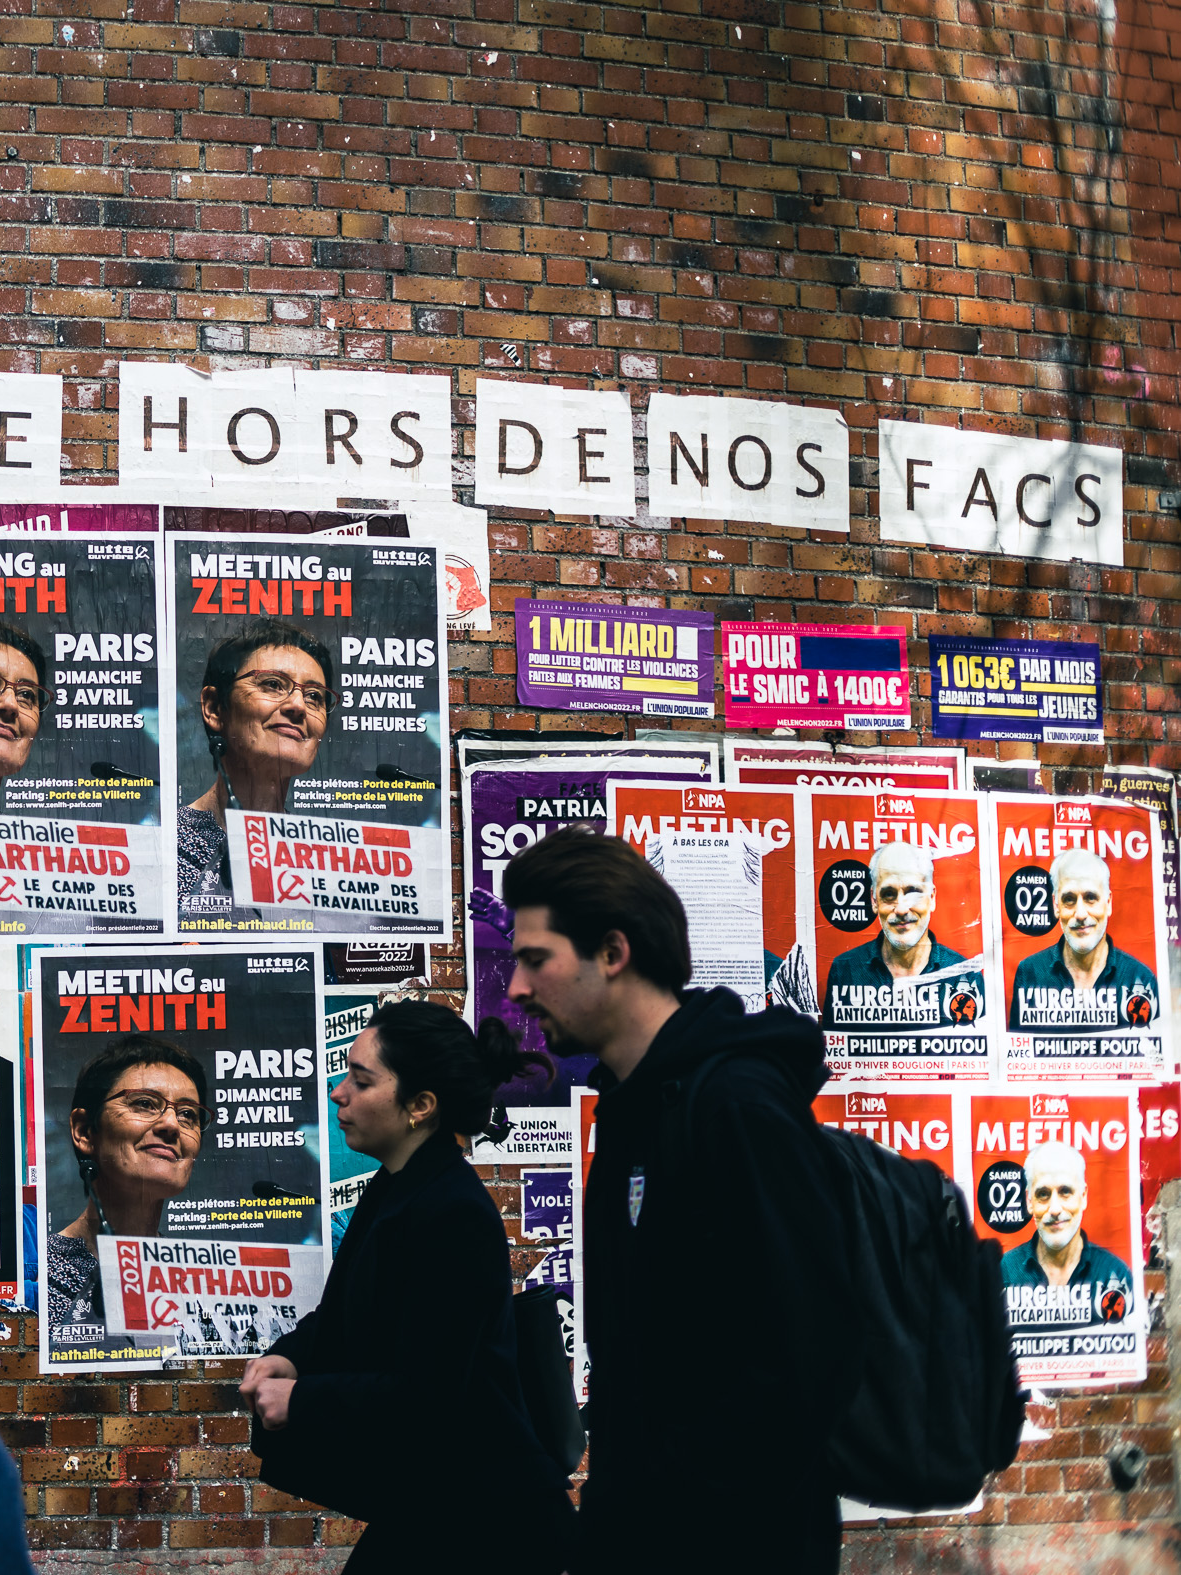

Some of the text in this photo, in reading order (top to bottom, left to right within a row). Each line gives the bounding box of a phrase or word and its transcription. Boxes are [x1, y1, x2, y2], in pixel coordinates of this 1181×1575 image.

[143, 395, 424, 469] HORS
[497, 418, 611, 484] DE
[669, 431, 826, 499] NOS
[905, 458, 1102, 528] FACS
[40, 563, 65, 577] au
[190, 554, 320, 580] MEETING
[192, 578, 352, 617] ZENITH
[55, 633, 153, 662] PARIS
[529, 616, 674, 659] 1 MILLIARD
[341, 637, 435, 667] PARIS
[728, 634, 797, 669] POUR
[55, 671, 142, 684] DIMANCHE
[583, 657, 698, 678] CONTRE VIOLENCES
[1020, 658, 1096, 685] PAR MOIS
[576, 674, 620, 690] FEMMES
[730, 671, 902, 706] LE SMIC À 1400€
[73, 689, 133, 706] AVRIL
[570, 701, 641, 711] MELENCHON2022.FR
[938, 690, 1097, 720] GARANTIS JEUNES
[76, 714, 144, 729] HEURES
[49, 791, 141, 800] Porte Villette
[890, 799, 915, 814] NPA
[680, 838, 696, 846] BAS
[716, 839, 729, 847] CRA
[819, 820, 976, 850] MEETING
[1003, 826, 1150, 860] MEETING
[274, 841, 413, 878] ARTHAUD
[832, 870, 865, 879] SAMEDI
[23, 879, 135, 897] LE CAMP DES
[831, 881, 865, 906] 02
[25, 895, 137, 914] TRAVAILLEURS
[831, 909, 868, 921] AVRIL
[379, 952, 407, 961] 2022
[58, 968, 195, 995] MEETING
[1019, 988, 1117, 1009] L'URGENCE
[59, 993, 226, 1033] ZENITH
[835, 1008, 939, 1022] ANTICAPITALISTE
[851, 1038, 986, 1054] PHILIPPE POUTOU
[216, 1048, 313, 1080] PARIS
[521, 1121, 557, 1130] UNION
[507, 1143, 572, 1152] LIBERTAIRE
[143, 1242, 236, 1265] Nathalie
[148, 1267, 292, 1298] ARTHAUD
